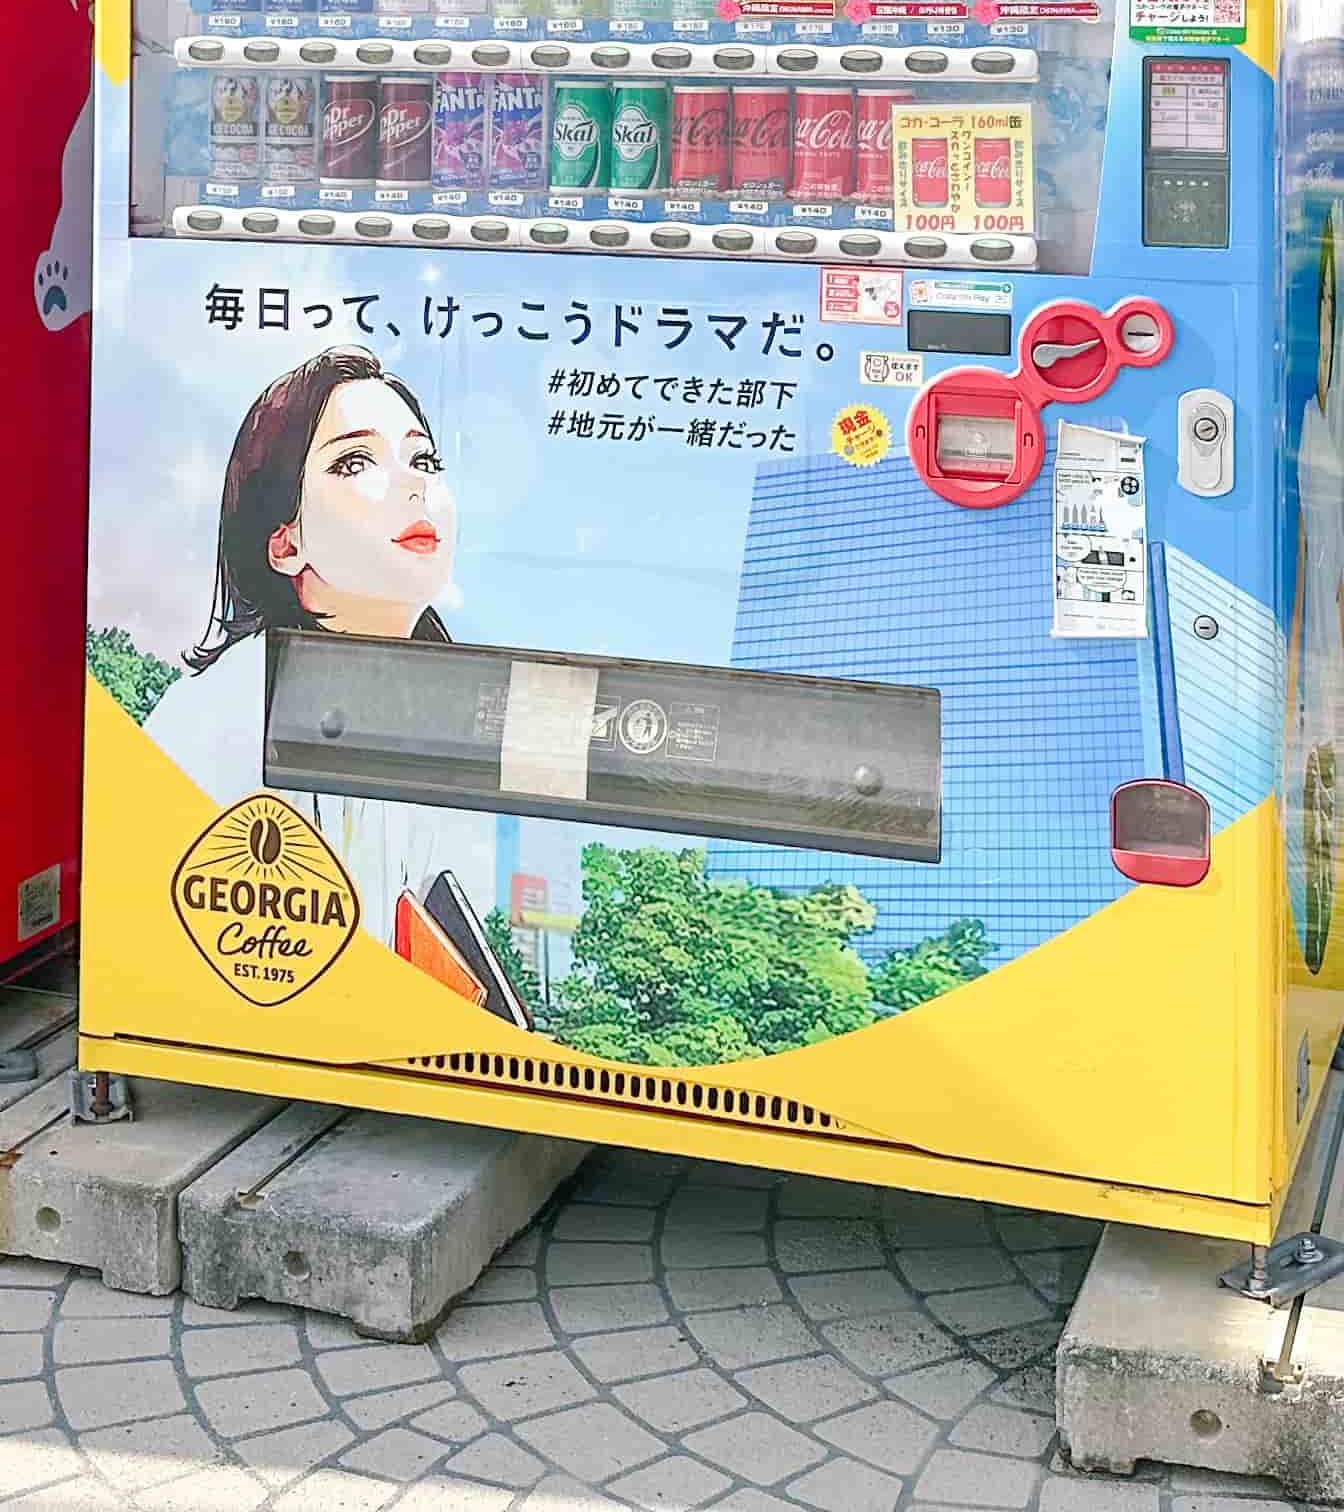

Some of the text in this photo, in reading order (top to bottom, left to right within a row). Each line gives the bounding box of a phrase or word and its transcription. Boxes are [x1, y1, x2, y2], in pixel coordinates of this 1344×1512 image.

[904, 214, 956, 231] 100円
[973, 214, 1024, 231] 100円
[203, 283, 835, 363] 毎日って、けっこうドラマだ。
[547, 367, 798, 410] #初めてできた部下
[895, 372, 913, 382] OK
[547, 409, 797, 453] #地元が一緒だった
[182, 874, 347, 928] GEORGIA
[216, 921, 313, 959] Coffee
[234, 963, 295, 984] EST. 1975
